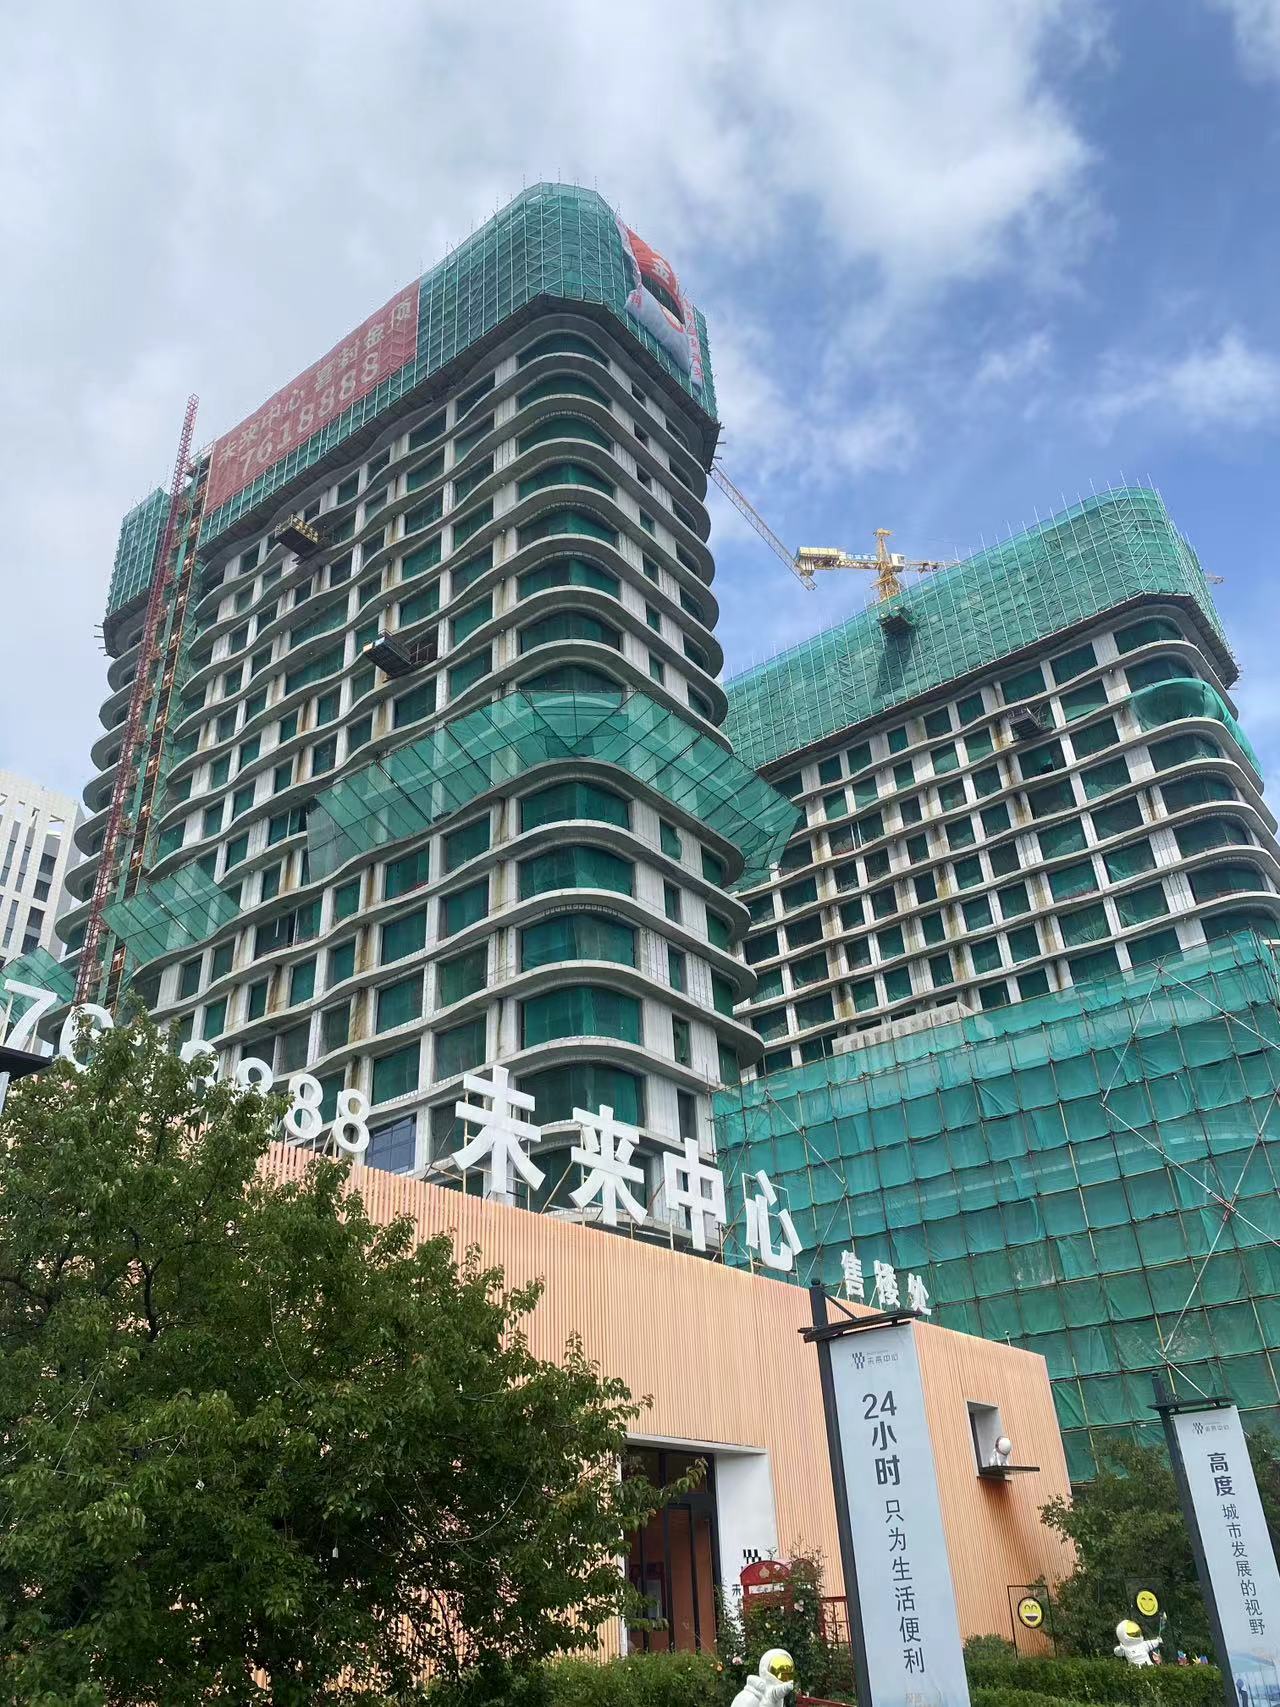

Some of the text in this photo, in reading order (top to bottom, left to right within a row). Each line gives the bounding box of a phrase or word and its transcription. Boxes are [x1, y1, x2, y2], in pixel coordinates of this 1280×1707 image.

[240, 351, 379, 479] 7618888
[452, 1064, 803, 1271] 未来中心
[841, 1250, 932, 1316] 售楼处
[862, 1390, 901, 1487] 24小时
[885, 1499, 925, 1675] 只为生活便利
[1207, 1451, 1265, 1636] 高度 城市发展的视野
